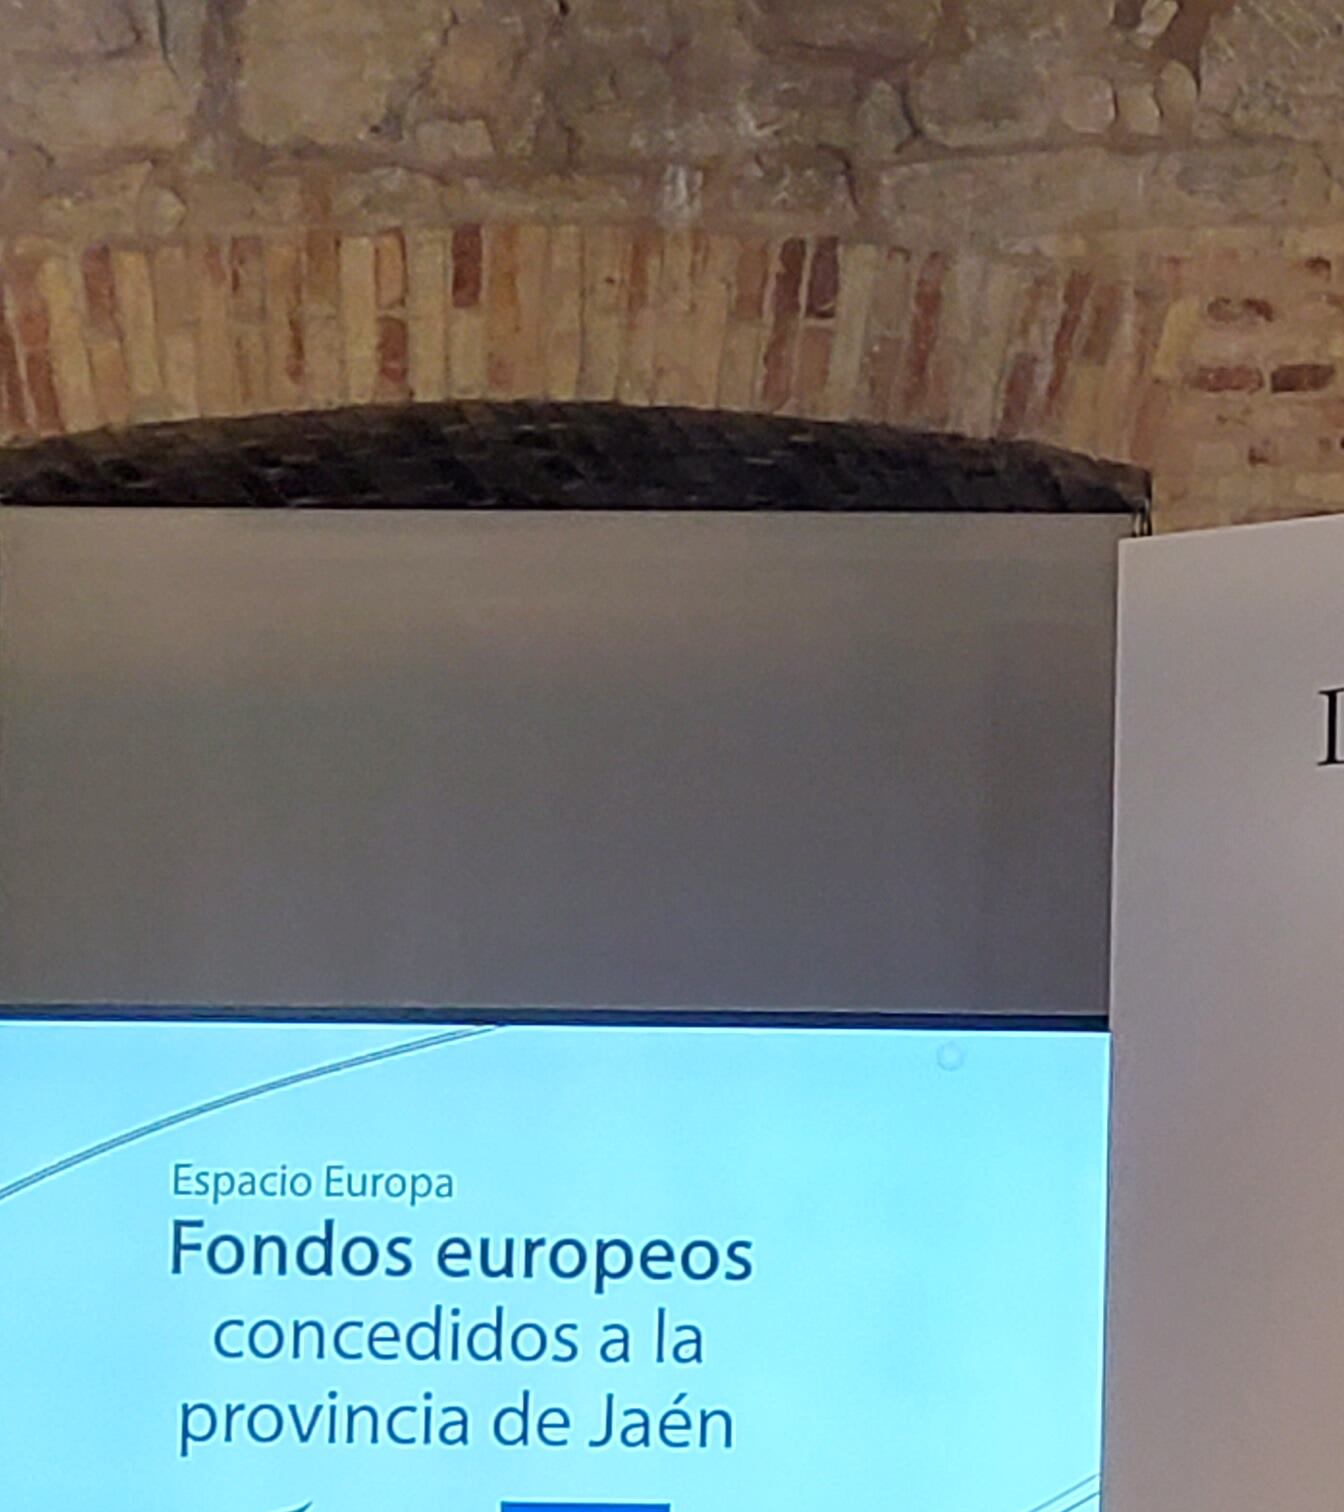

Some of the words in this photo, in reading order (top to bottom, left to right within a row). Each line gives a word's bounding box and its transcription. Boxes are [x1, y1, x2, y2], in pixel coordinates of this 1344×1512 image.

[173, 1163, 312, 1206] Espacio
[325, 1165, 454, 1208] Europa
[170, 1218, 414, 1278] Fondos
[436, 1236, 754, 1295] europeos
[213, 1304, 579, 1364] concedidos
[599, 1322, 631, 1364] a
[656, 1307, 704, 1364] la
[179, 1389, 470, 1458] provincia
[493, 1389, 572, 1448] de
[588, 1392, 733, 1450] Jaén
